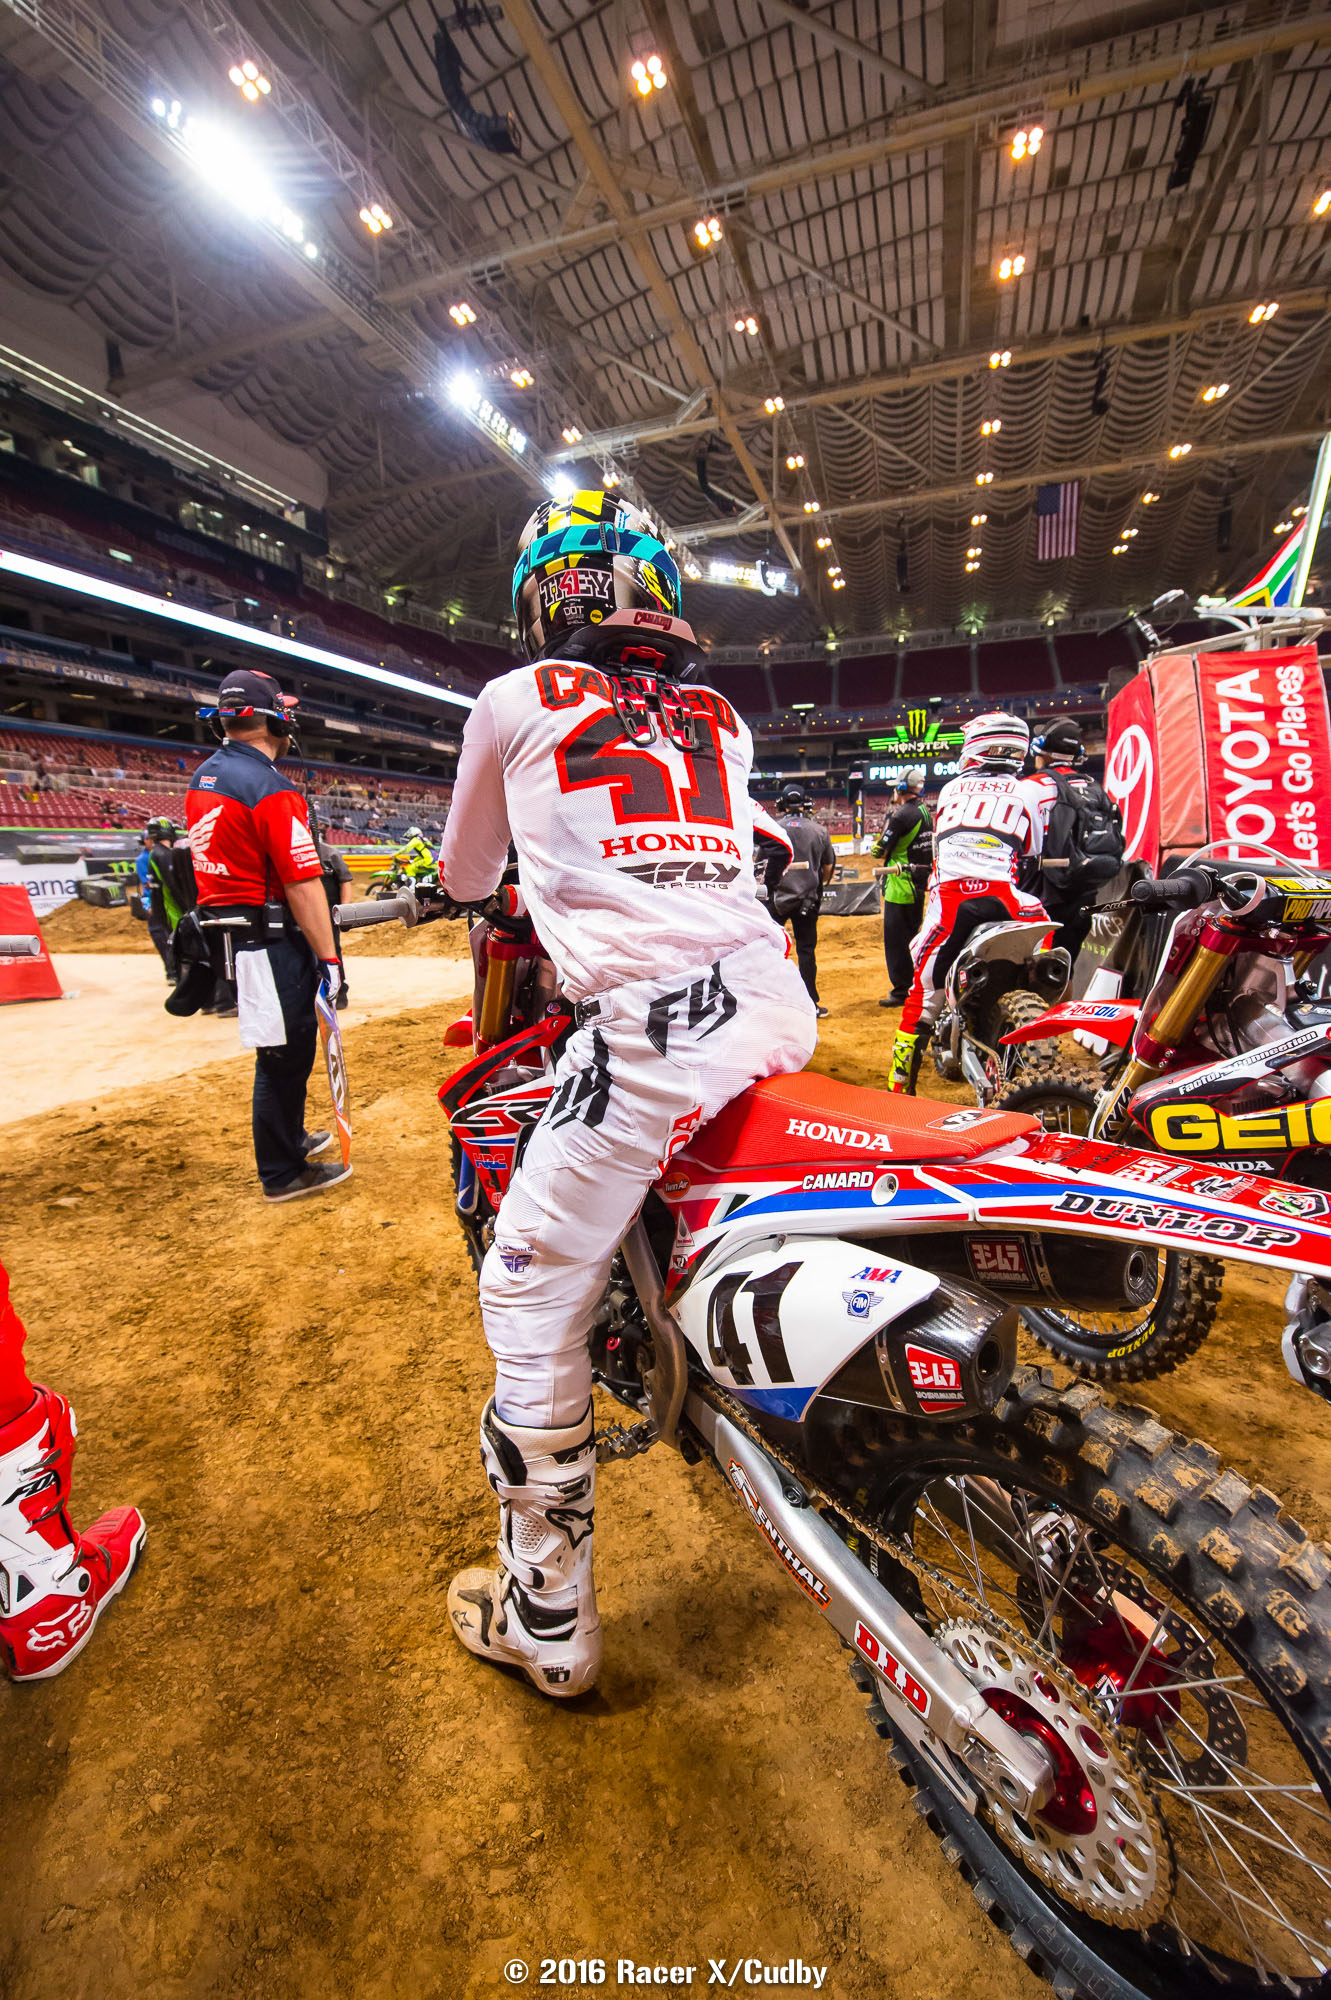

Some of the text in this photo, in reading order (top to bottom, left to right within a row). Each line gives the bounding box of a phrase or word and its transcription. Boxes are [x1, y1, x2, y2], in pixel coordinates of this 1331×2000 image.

[563, 605, 585, 616] DOT
[1276, 664, 1311, 748] Places
[887, 740, 950, 754] MONSTER
[554, 707, 735, 829] 41
[869, 763, 927, 780] FINIH
[1216, 668, 1277, 866] TOYOTA
[1282, 752, 1314, 794] Go
[949, 781, 1016, 797] ALESSI
[936, 794, 1026, 835] 800
[599, 833, 742, 861] HONDA
[1285, 801, 1320, 867] Let's
[616, 861, 742, 885] FLY
[1067, 1006, 1121, 1018] AMSOIL
[785, 1118, 894, 1153] HONDA
[472, 1152, 508, 1170] HRC
[801, 1170, 875, 1191] CANARD
[1053, 1192, 1301, 1248] DUNLOP
[972, 1244, 1020, 1271] ヨシムラ
[849, 1266, 903, 1284] AMA
[852, 1296, 868, 1309] FIM
[706, 1261, 804, 1386] 41
[1107, 1321, 1156, 1359] DUNLOP
[909, 1361, 956, 1387] ヨシムラ
[915, 1390, 965, 1400] YOSHIMURA
[857, 1622, 928, 1714] D.I.D
